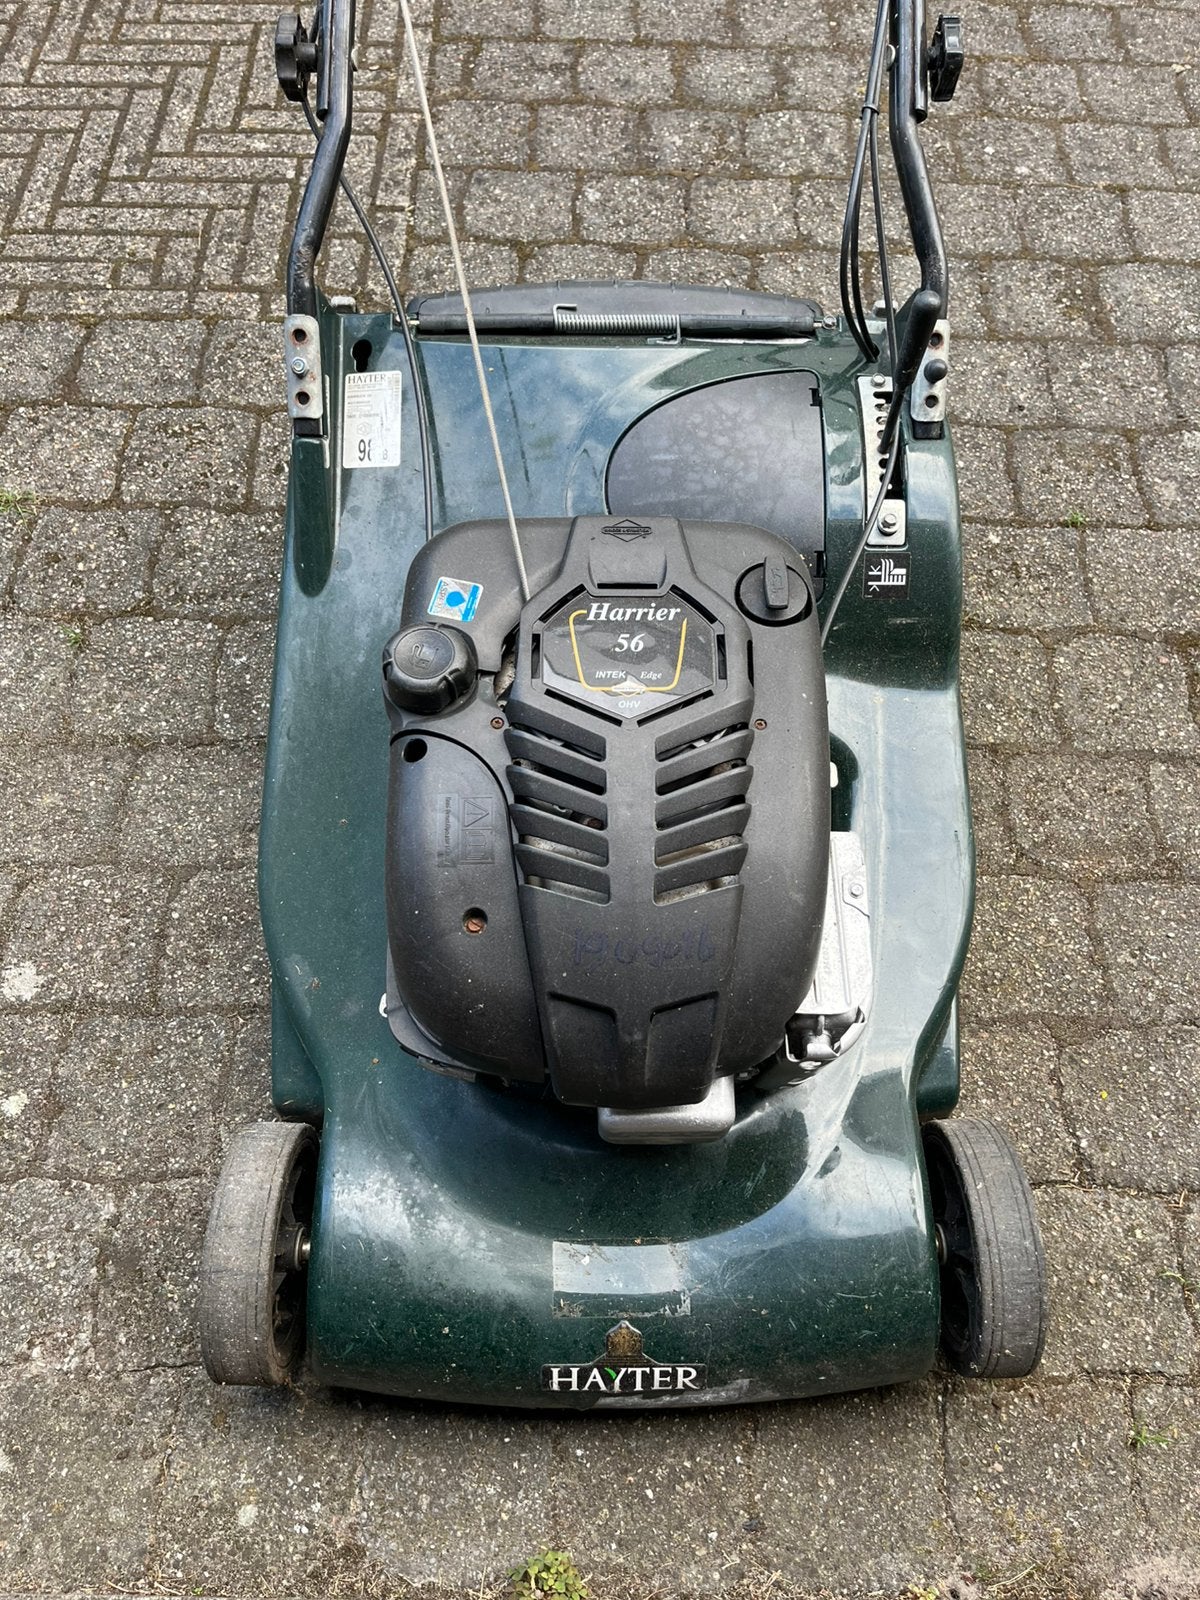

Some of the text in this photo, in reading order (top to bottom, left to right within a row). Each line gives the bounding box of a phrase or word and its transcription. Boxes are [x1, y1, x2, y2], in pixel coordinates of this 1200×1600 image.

[347, 374, 387, 384] HAYTER
[587, 602, 681, 621] Harrier
[614, 632, 646, 652] 56
[595, 670, 663, 681] INTEK Edge
[618, 700, 641, 709] OHV
[550, 1366, 700, 1393] HAYTER
